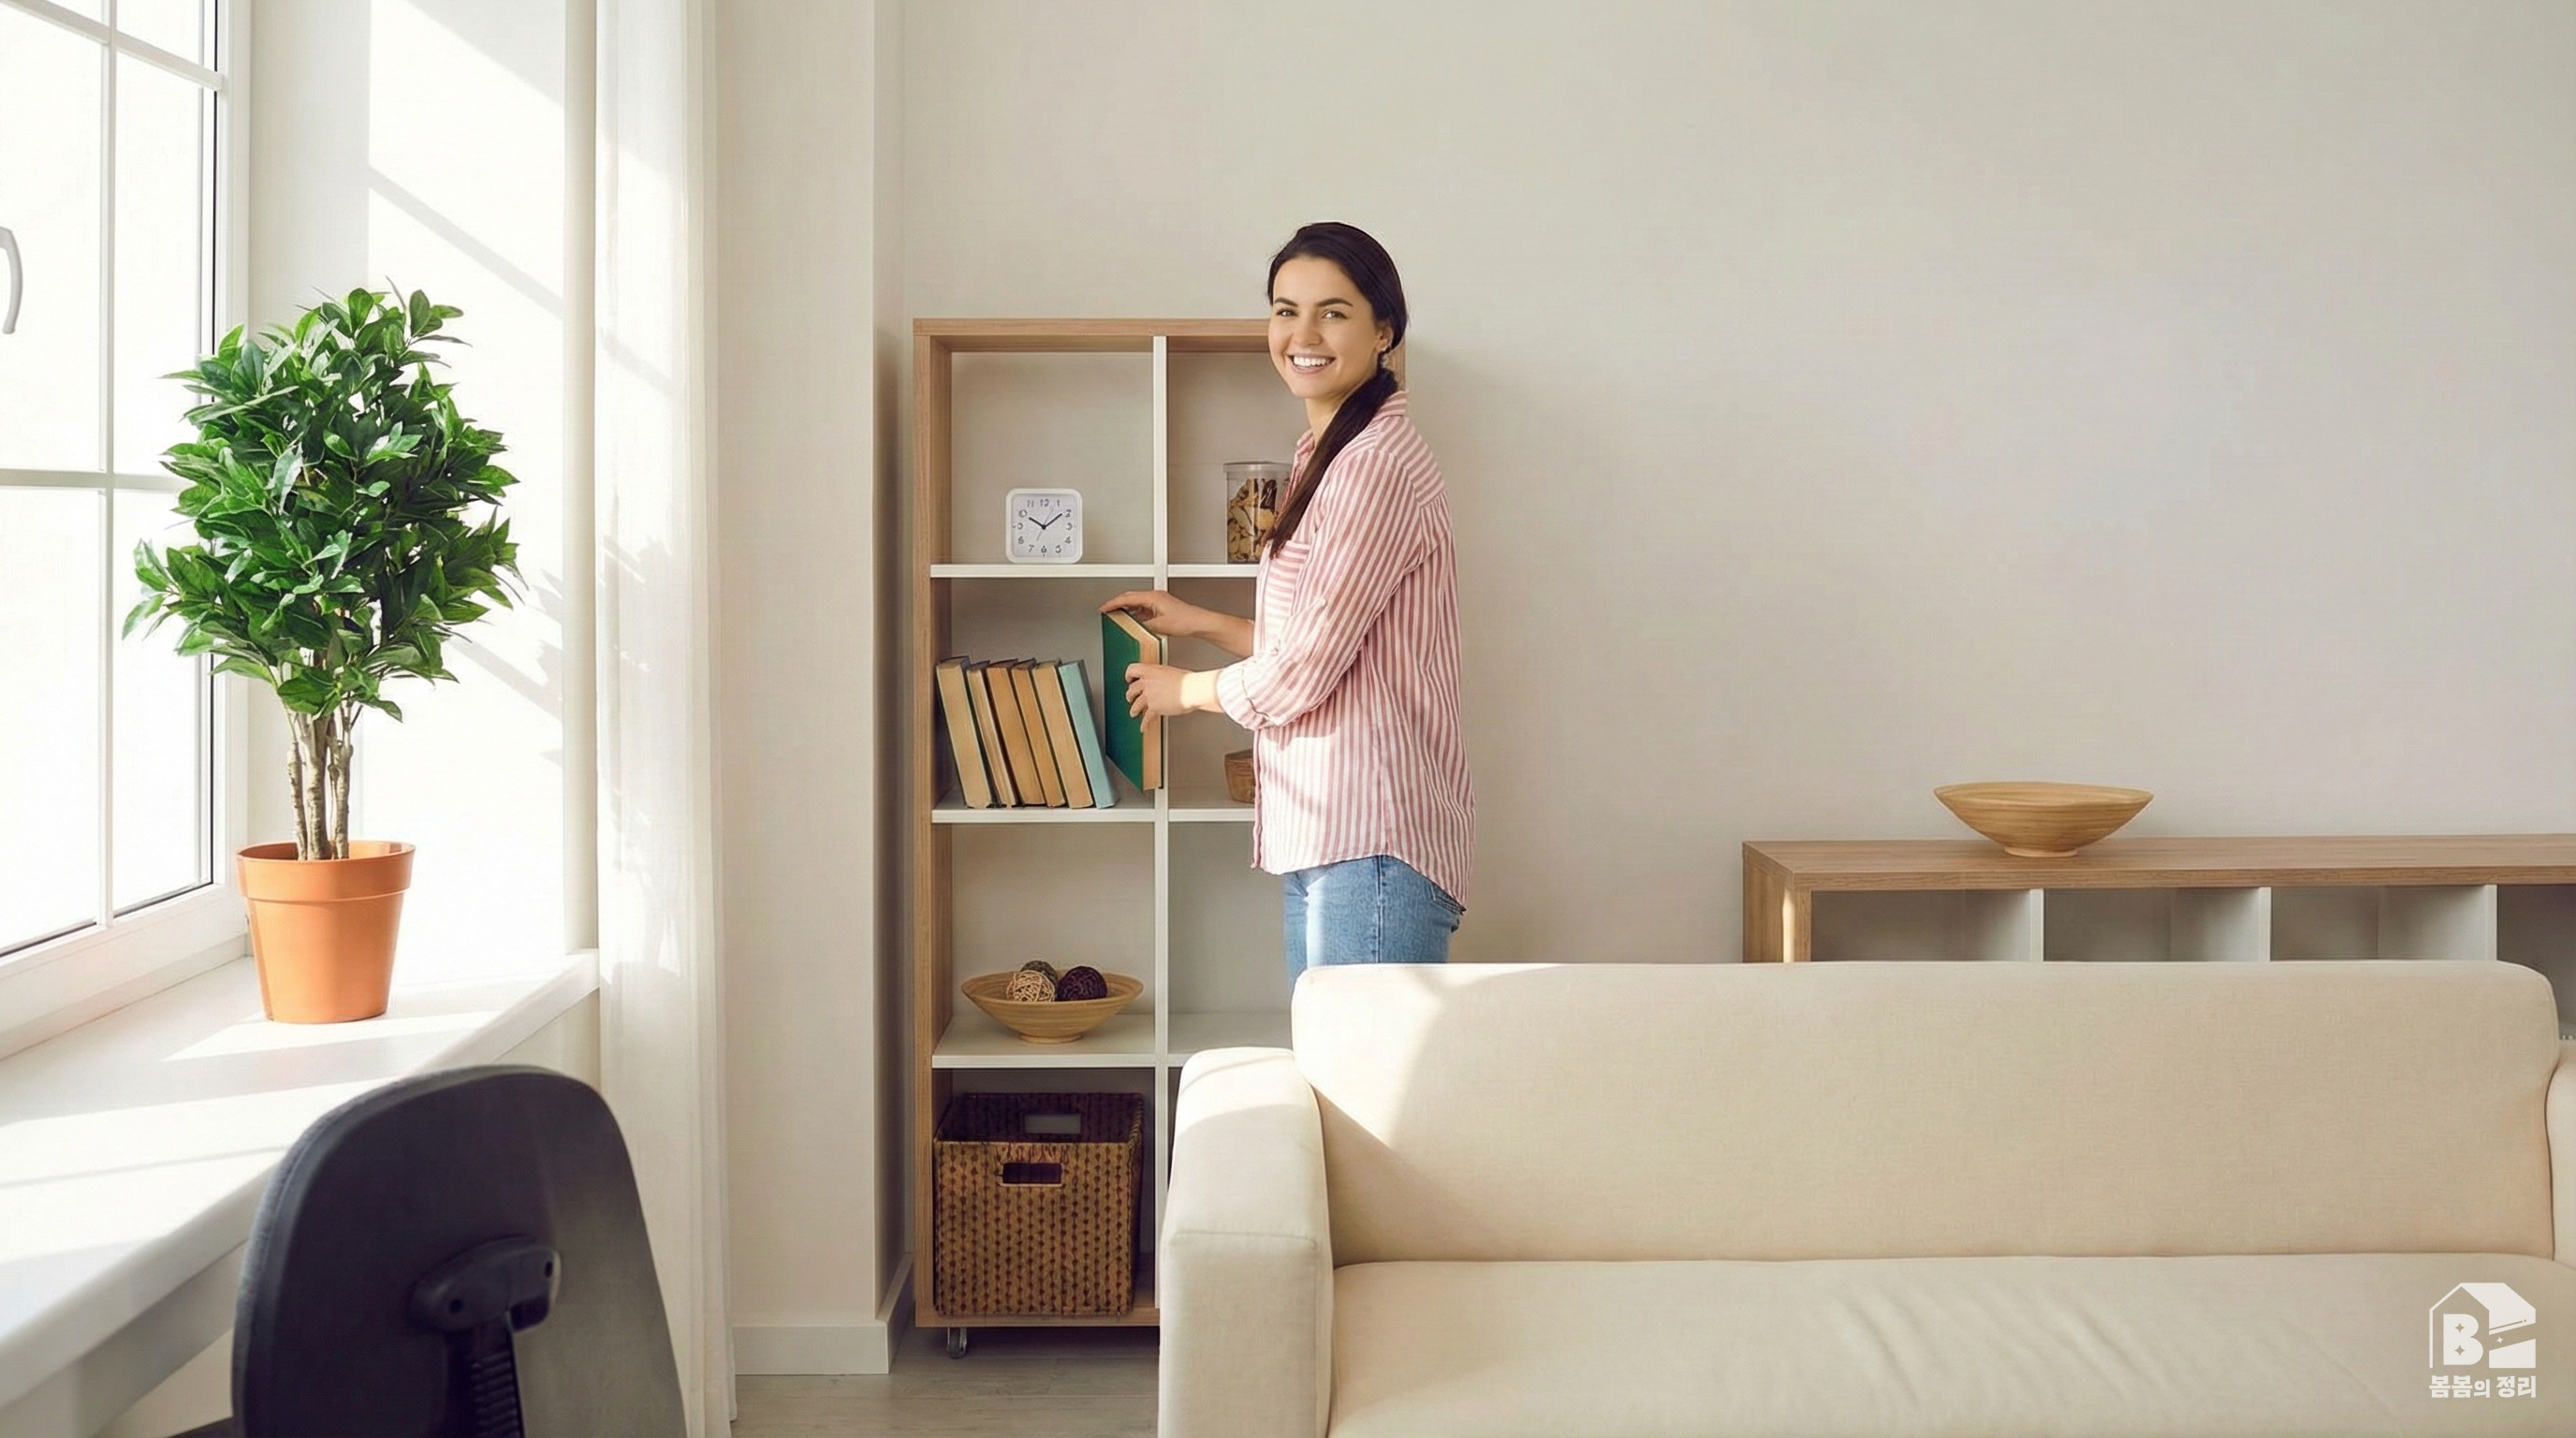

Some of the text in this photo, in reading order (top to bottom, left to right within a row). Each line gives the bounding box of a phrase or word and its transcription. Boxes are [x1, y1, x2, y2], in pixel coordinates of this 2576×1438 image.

[1039, 498, 1049, 507] 12
[1028, 544, 1034, 553] 7
[1041, 545, 1047, 553] 6
